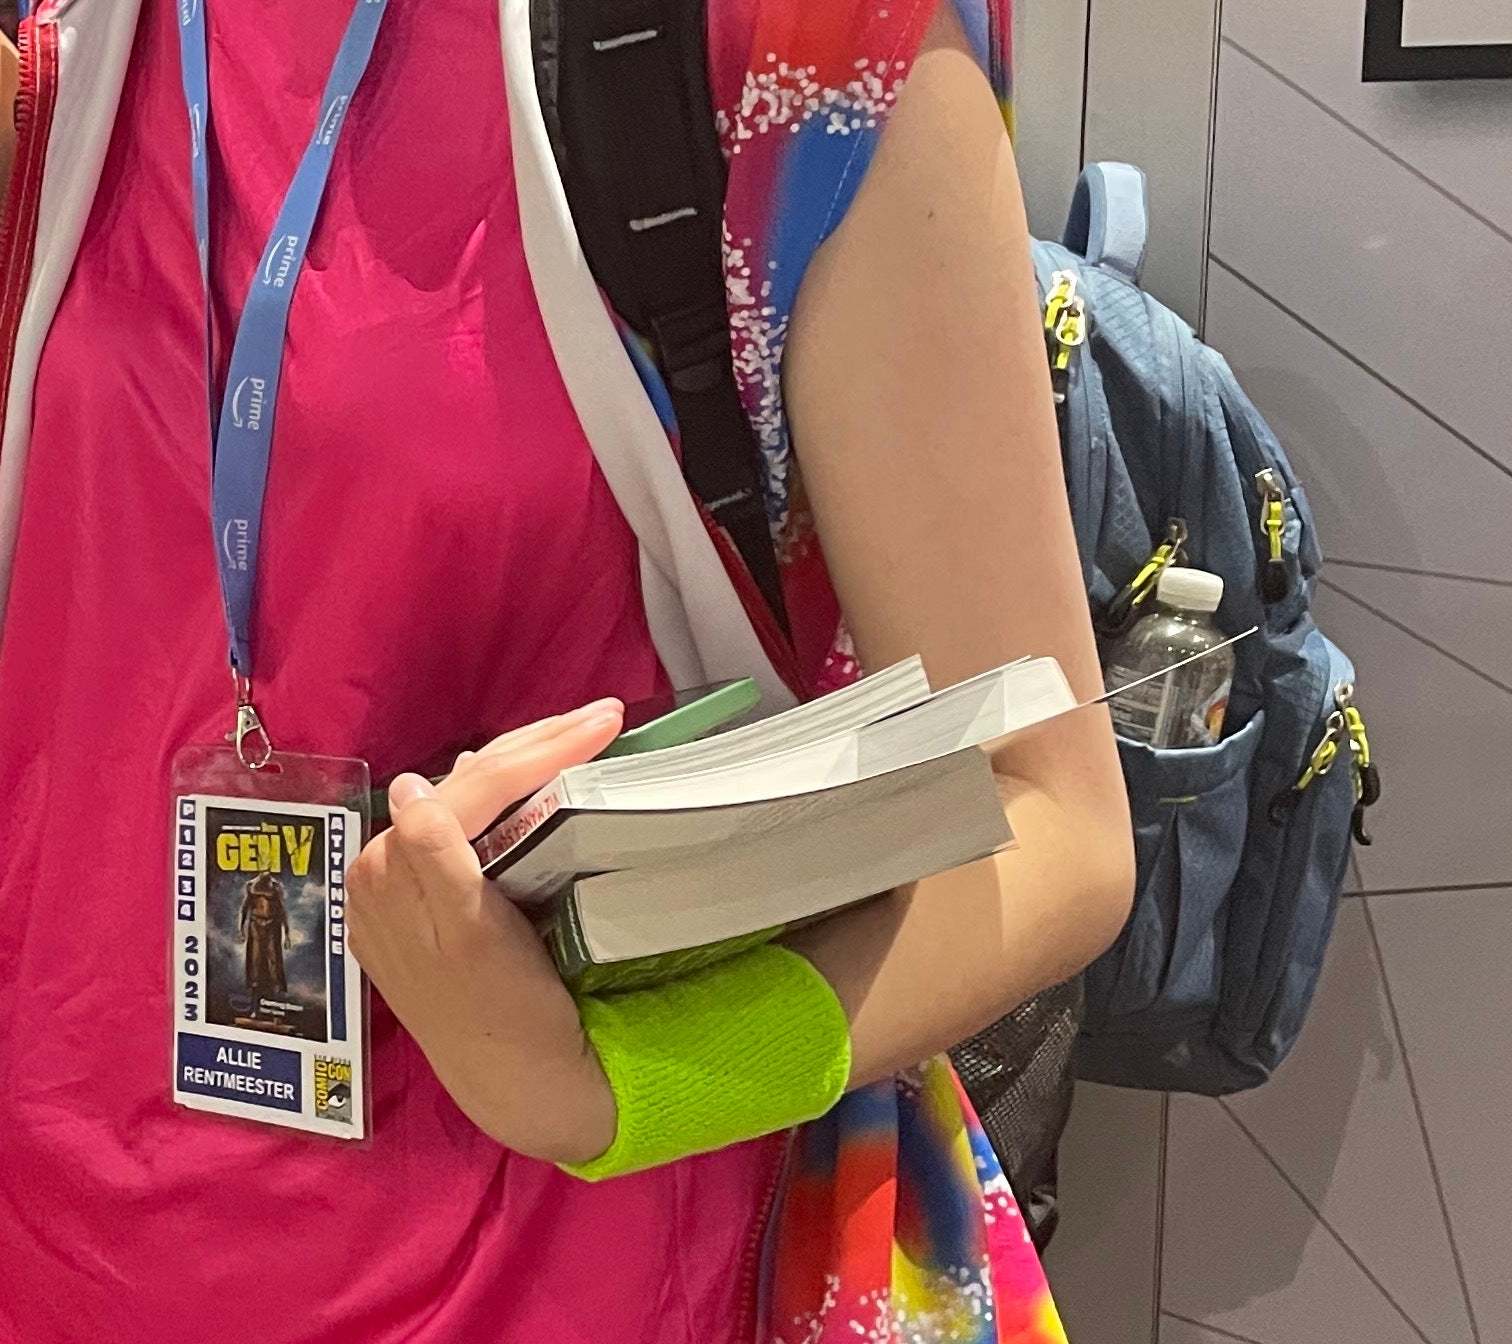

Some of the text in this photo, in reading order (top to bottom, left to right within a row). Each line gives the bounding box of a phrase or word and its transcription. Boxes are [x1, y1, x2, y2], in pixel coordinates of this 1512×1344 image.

[273, 235, 298, 288] prime
[248, 377, 265, 431] prime
[233, 518, 248, 571] prime
[216, 825, 315, 876] GEN V
[330, 816, 345, 956] ATTENDEE
[184, 935, 199, 1022] 2023
[183, 1065, 295, 1101] RENTMEESTER
[216, 1045, 262, 1070] ALLIE
[316, 1060, 351, 1111] COMIC CON
